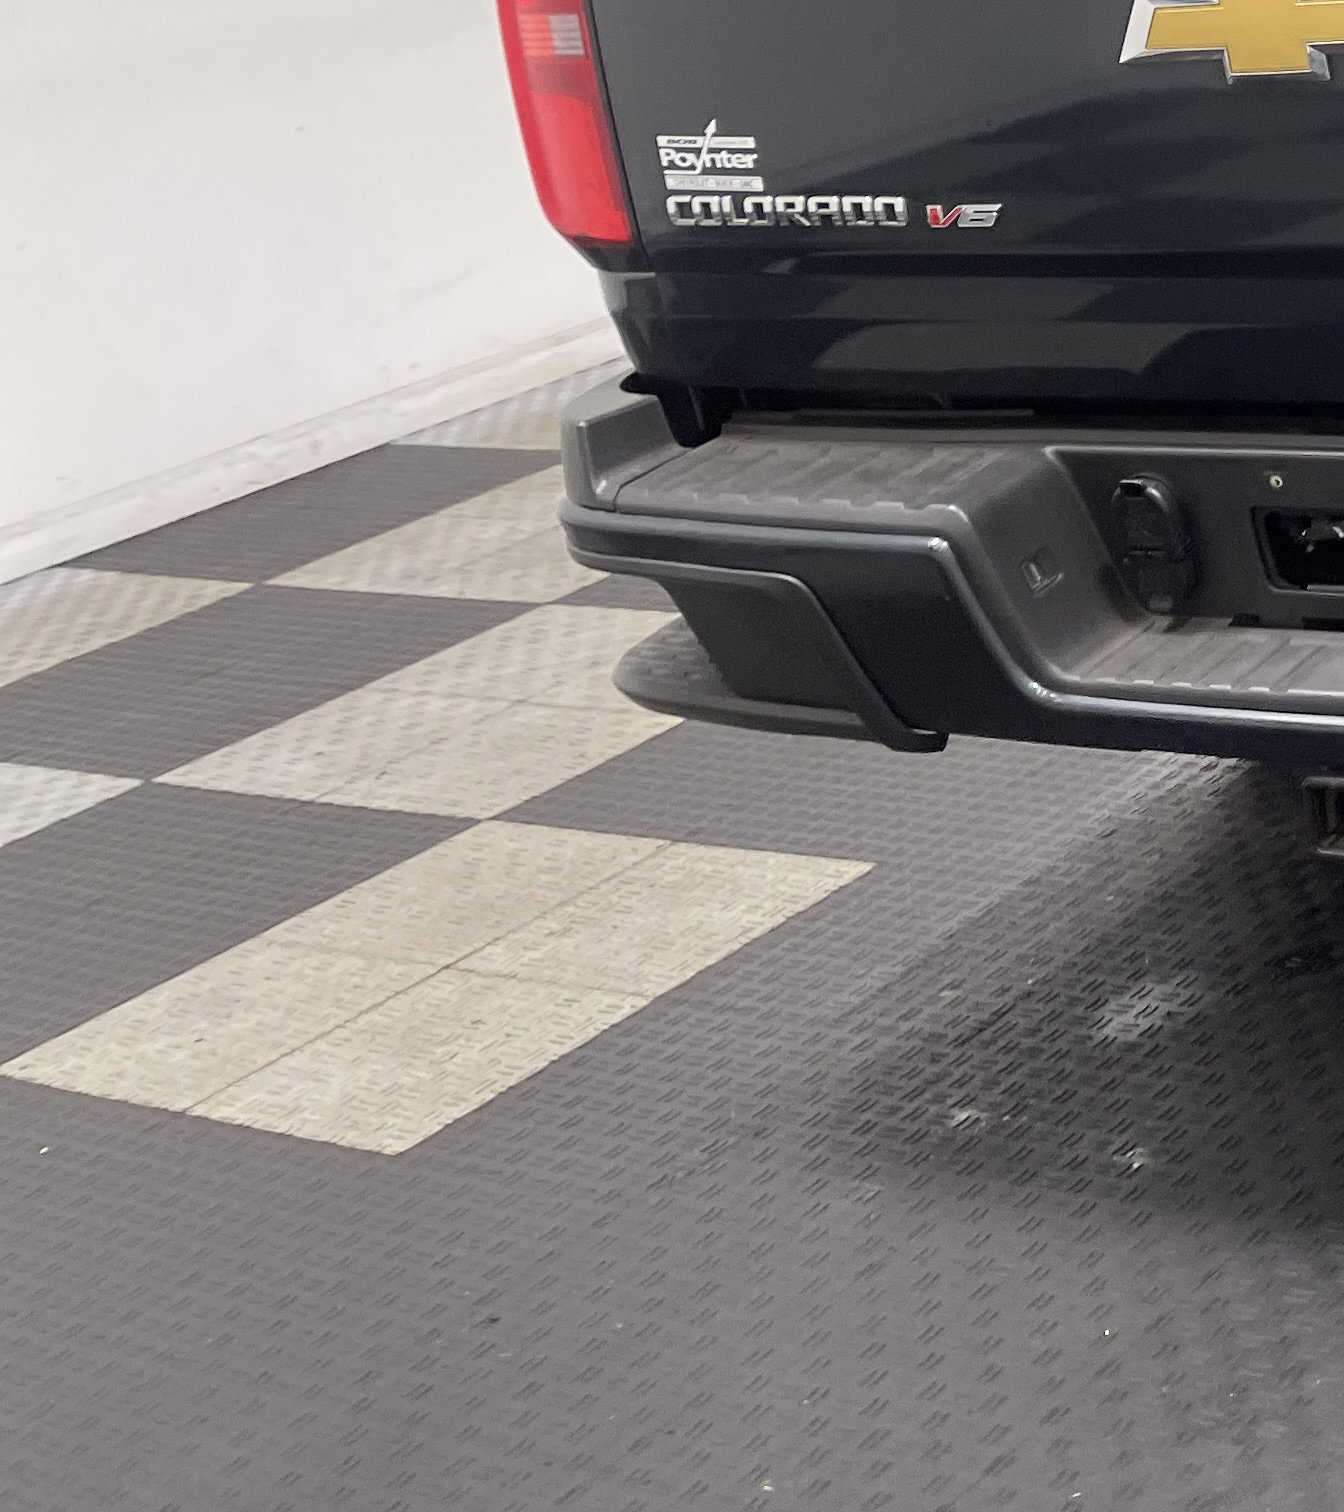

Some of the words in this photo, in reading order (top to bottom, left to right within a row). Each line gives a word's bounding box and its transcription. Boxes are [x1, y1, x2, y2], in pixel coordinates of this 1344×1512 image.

[658, 146, 759, 173] Poynter
[666, 194, 907, 226] COLORADO
[926, 204, 1002, 228] V6
